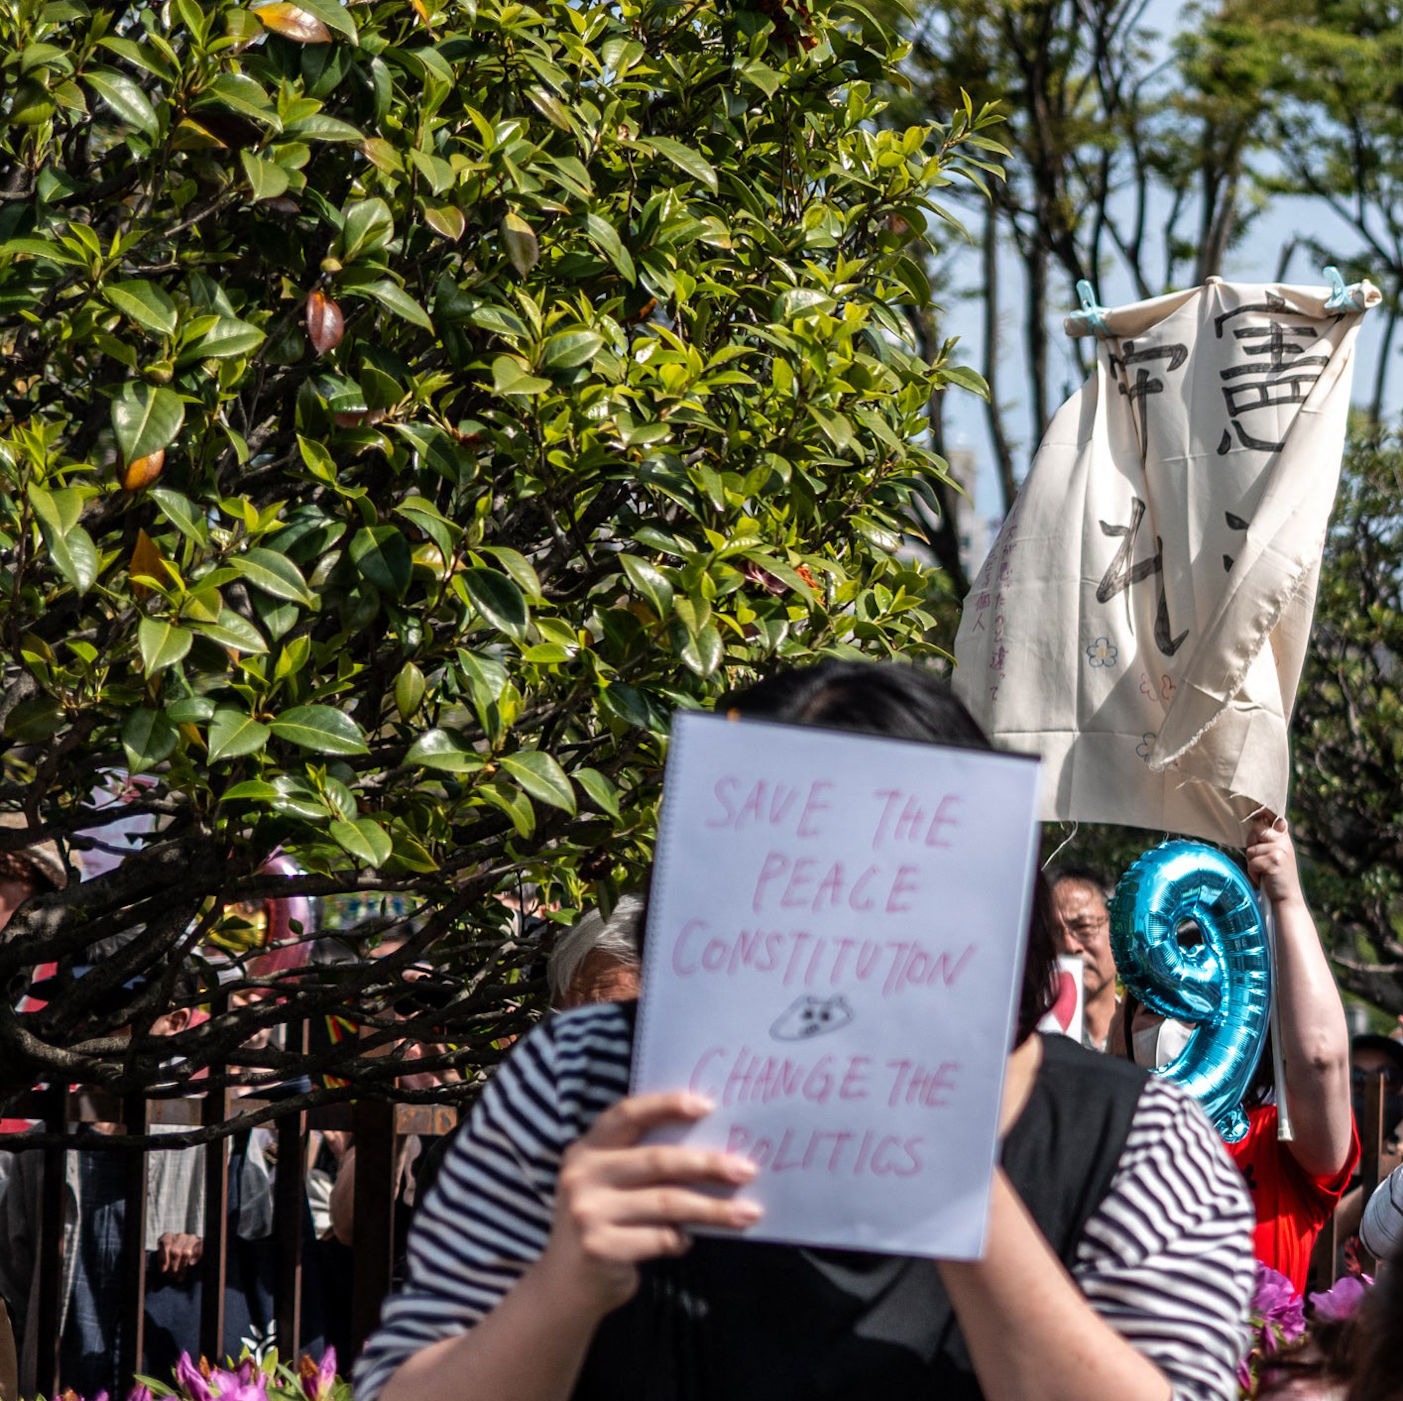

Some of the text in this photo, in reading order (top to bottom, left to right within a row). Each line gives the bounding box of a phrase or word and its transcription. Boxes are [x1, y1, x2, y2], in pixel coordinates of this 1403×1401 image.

[706, 775, 964, 849] SAVE THE
[752, 852, 920, 914] PEACE
[671, 920, 980, 995] CONSTITUTION
[1109, 840, 1272, 1143] 9
[690, 1046, 964, 1107] CHANGE THE
[724, 1125, 927, 1177] POLITICS
